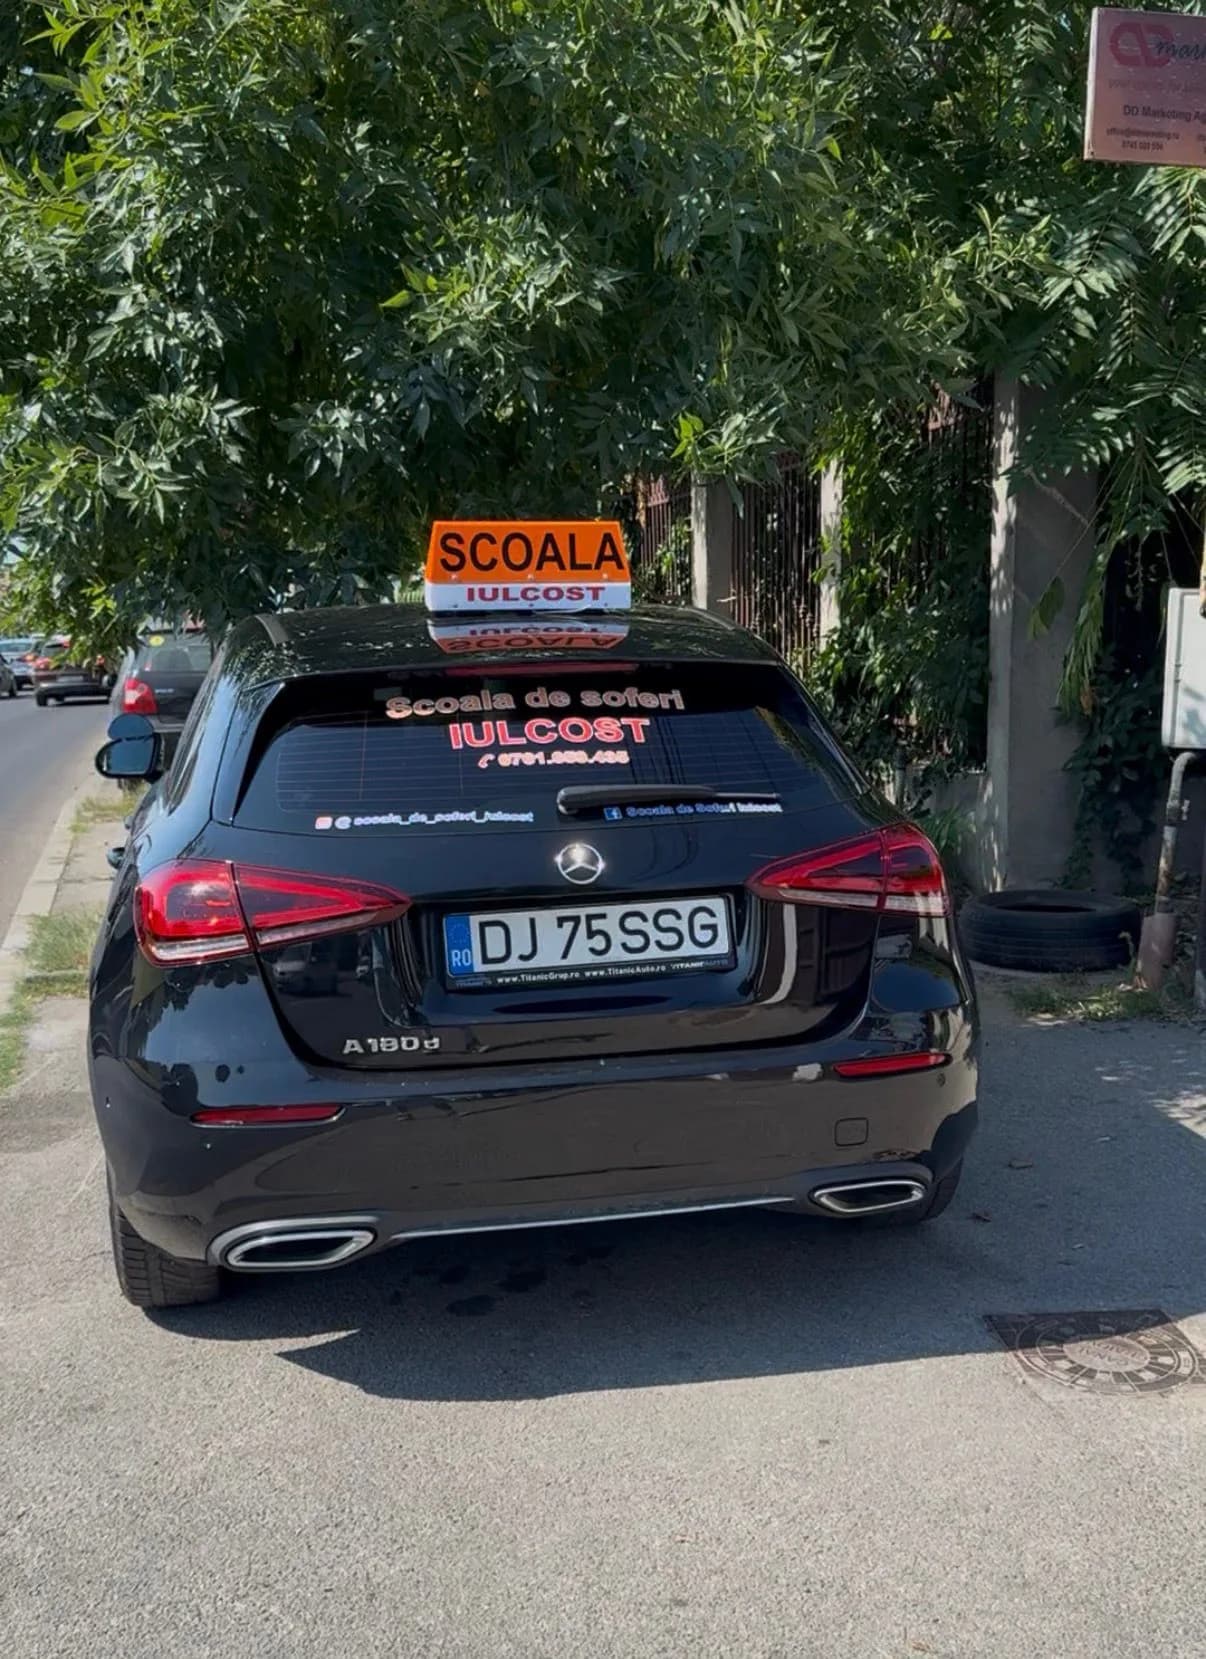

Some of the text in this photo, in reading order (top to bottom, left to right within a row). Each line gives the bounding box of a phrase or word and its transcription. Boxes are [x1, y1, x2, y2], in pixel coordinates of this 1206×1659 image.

[439, 532, 624, 571] SCOALA
[467, 586, 605, 601] IULCOST
[385, 687, 685, 719] Scoala de soferi
[449, 717, 650, 749] IULCOST
[478, 917, 538, 964] DJ
[452, 950, 471, 967] RO
